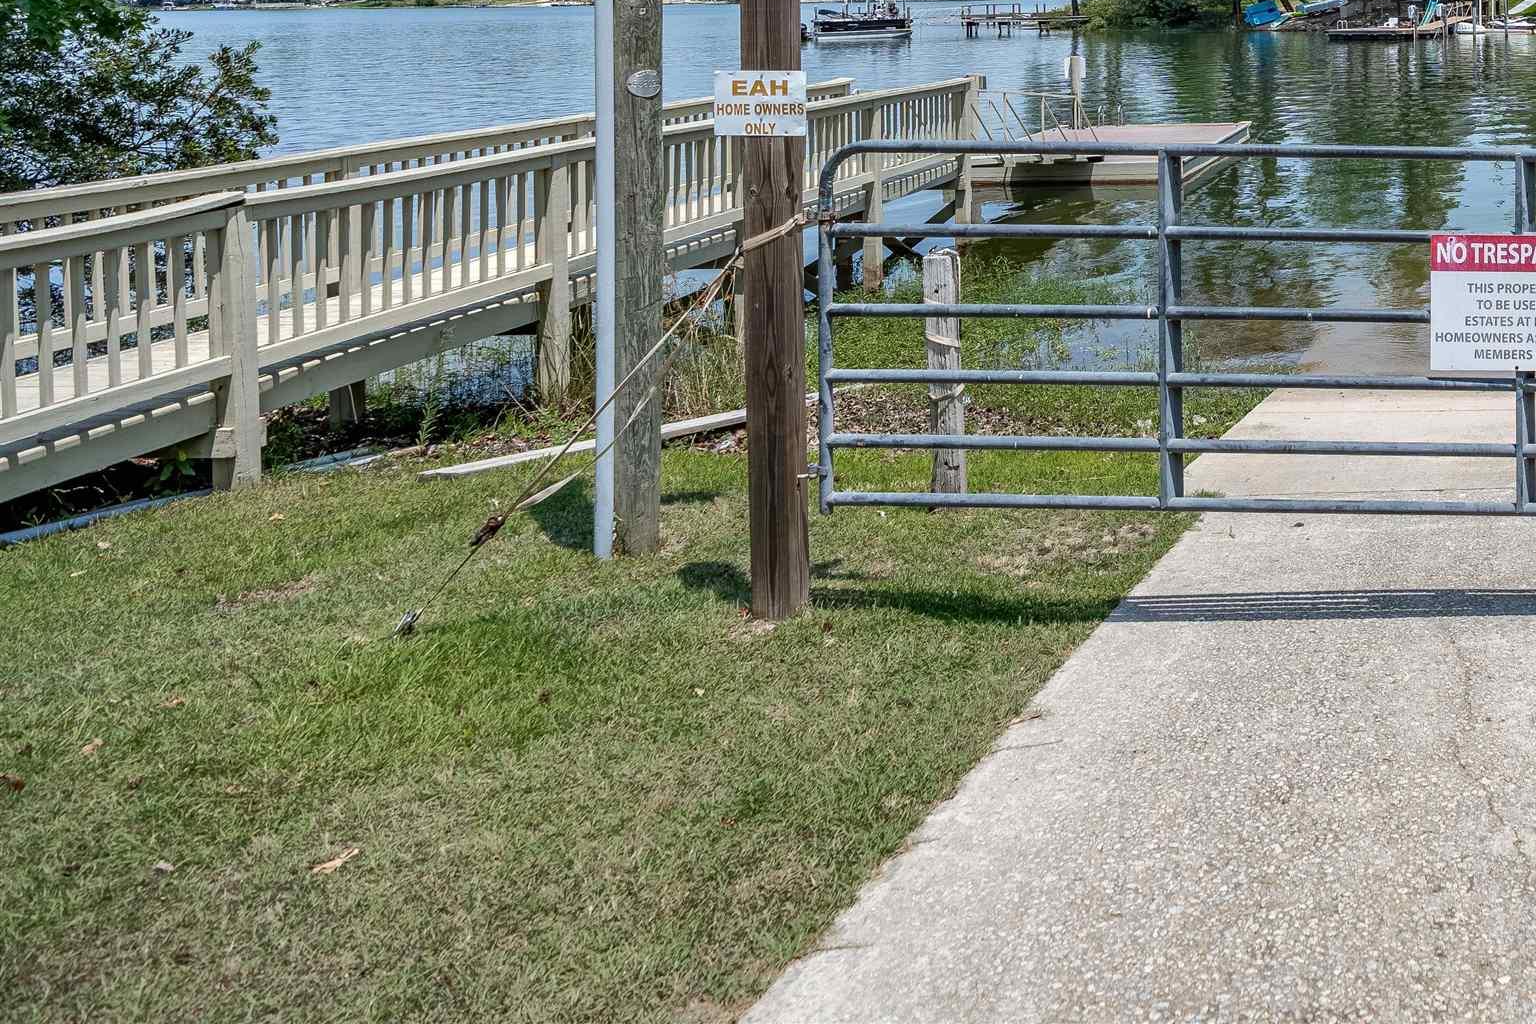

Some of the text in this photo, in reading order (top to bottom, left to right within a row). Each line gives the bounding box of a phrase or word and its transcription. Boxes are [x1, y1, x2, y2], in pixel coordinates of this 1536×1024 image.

[732, 80, 789, 96] EAH
[716, 103, 804, 116] HOME OWNERS
[744, 122, 776, 135] ONLY
[1436, 242, 1467, 264] NO
[1467, 282, 1494, 294] THIS
[1477, 299, 1493, 310] TO
[1495, 299, 1510, 311] BE
[1464, 315, 1513, 327] ESTATES
[1516, 316, 1531, 327] AT
[1435, 331, 1524, 344] HOMEOWNERS
[1474, 348, 1533, 361] MEMBERS
